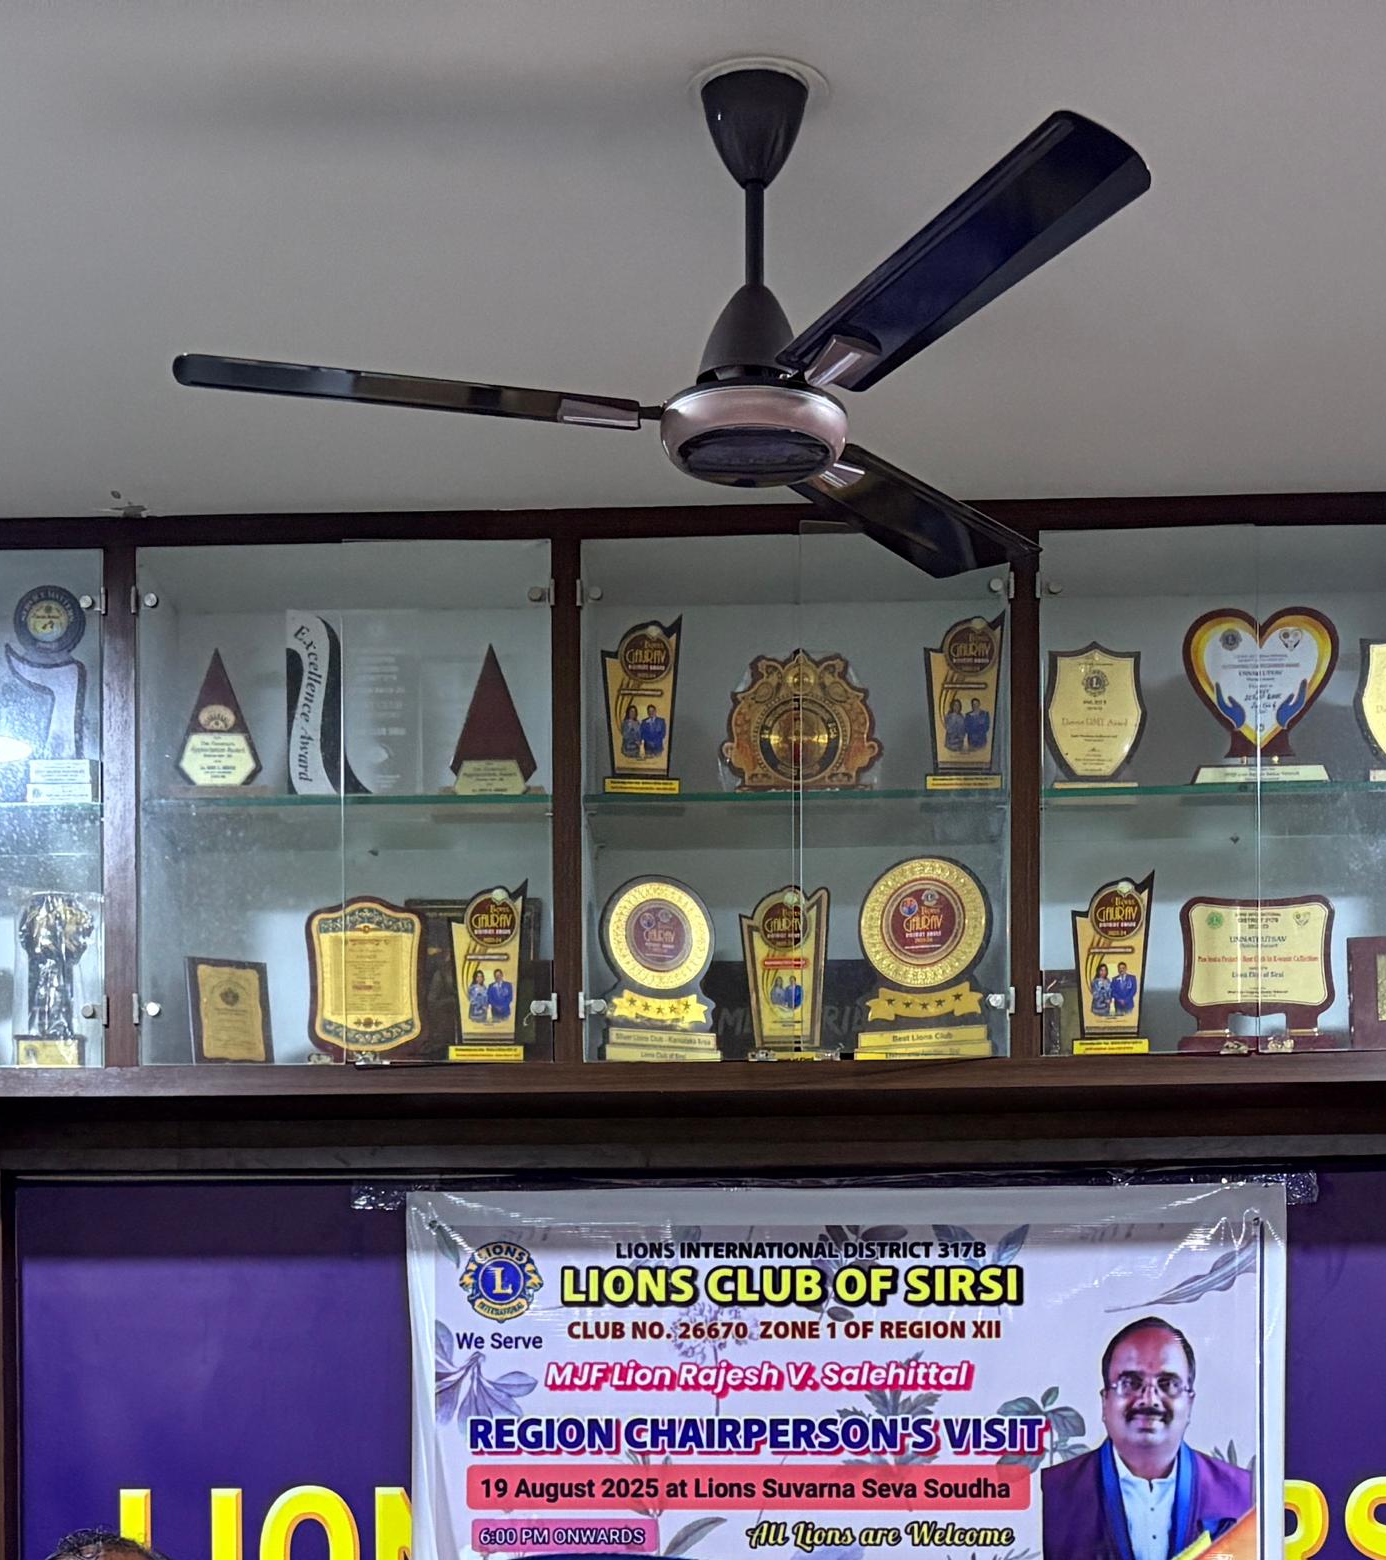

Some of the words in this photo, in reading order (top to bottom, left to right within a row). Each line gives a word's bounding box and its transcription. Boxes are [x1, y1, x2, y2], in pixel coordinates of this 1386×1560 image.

[294, 625, 322, 722] Excellence
[299, 727, 314, 782] Award
[1096, 906, 1138, 922] GAURAV
[476, 1244, 527, 1262] IONS
[616, 1242, 675, 1259] LIONS
[680, 1242, 839, 1259] INTERNATIONAL
[844, 1242, 934, 1259] DISTRICT
[938, 1241, 987, 1259] 317B
[493, 1267, 513, 1294] L
[561, 1265, 697, 1306] LIONS
[707, 1265, 825, 1306] CLUB
[834, 1265, 898, 1305] OF
[906, 1264, 1023, 1305] SIRSI
[456, 1332, 485, 1349] We
[490, 1332, 543, 1349] Serve
[567, 1321, 625, 1340] CLUB
[632, 1321, 672, 1340] NO.
[678, 1321, 748, 1339] 26670
[759, 1321, 820, 1340] ZONE
[826, 1321, 837, 1339] 1
[844, 1321, 874, 1340] OF
[881, 1321, 966, 1340] REGION
[972, 1321, 1002, 1339] XII
[545, 1362, 611, 1389] MJF
[612, 1361, 674, 1389] Lion
[678, 1361, 782, 1397] Rajesh
[785, 1362, 817, 1389] V.
[822, 1361, 973, 1390] Salehittal
[469, 1417, 617, 1453] REGION
[624, 1417, 938, 1454] CHAIRPERSON'S
[943, 1417, 1048, 1454] VISIT
[481, 1478, 508, 1498] 19
[514, 1478, 596, 1503] August
[600, 1478, 659, 1498] 2025
[665, 1480, 689, 1498] at
[694, 1478, 756, 1498] Lions
[762, 1478, 855, 1499] Suvarna
[862, 1478, 917, 1499] Seva
[924, 1477, 1011, 1499] Soudha
[479, 1527, 516, 1545] 6:00
[521, 1527, 550, 1545] PM
[553, 1527, 646, 1545] ONWARDS
[746, 1521, 790, 1548] All
[792, 1521, 856, 1552] Lions
[859, 1525, 903, 1547] are
[905, 1521, 1015, 1547] Welcome
